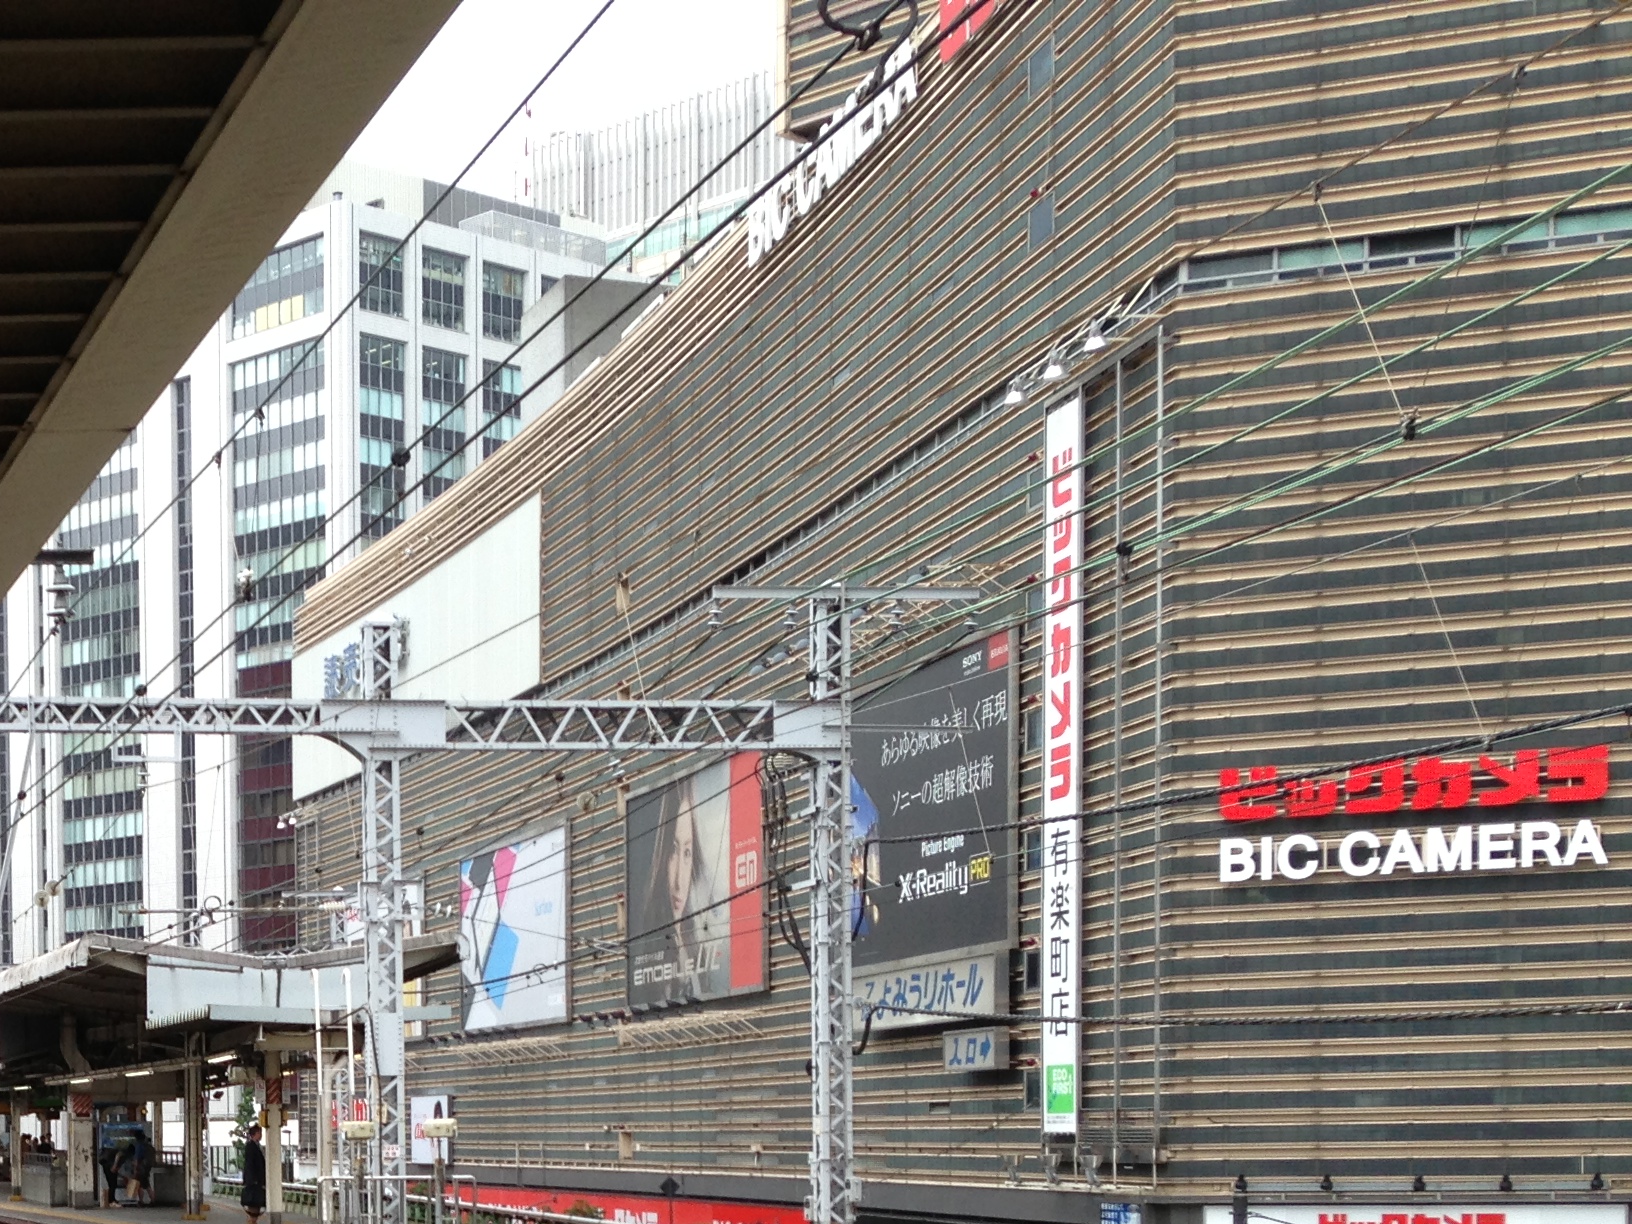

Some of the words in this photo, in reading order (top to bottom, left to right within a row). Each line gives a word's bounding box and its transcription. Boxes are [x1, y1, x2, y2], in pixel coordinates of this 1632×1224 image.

[1052, 447, 1072, 801] ビックカメラ
[962, 650, 982, 669] SONY
[892, 755, 994, 816] ソニーの超解像技術
[1219, 745, 1609, 820] ビックカメラ
[921, 839, 943, 857] Picture
[944, 834, 965, 853] Engine
[970, 856, 991, 880] PRO
[1219, 834, 1319, 882] BIC
[1339, 819, 1609, 877] CAMERA
[1049, 827, 1070, 1036] 有楽町店
[633, 958, 695, 986] EMOBILE
[948, 1037, 977, 1066] 入口
